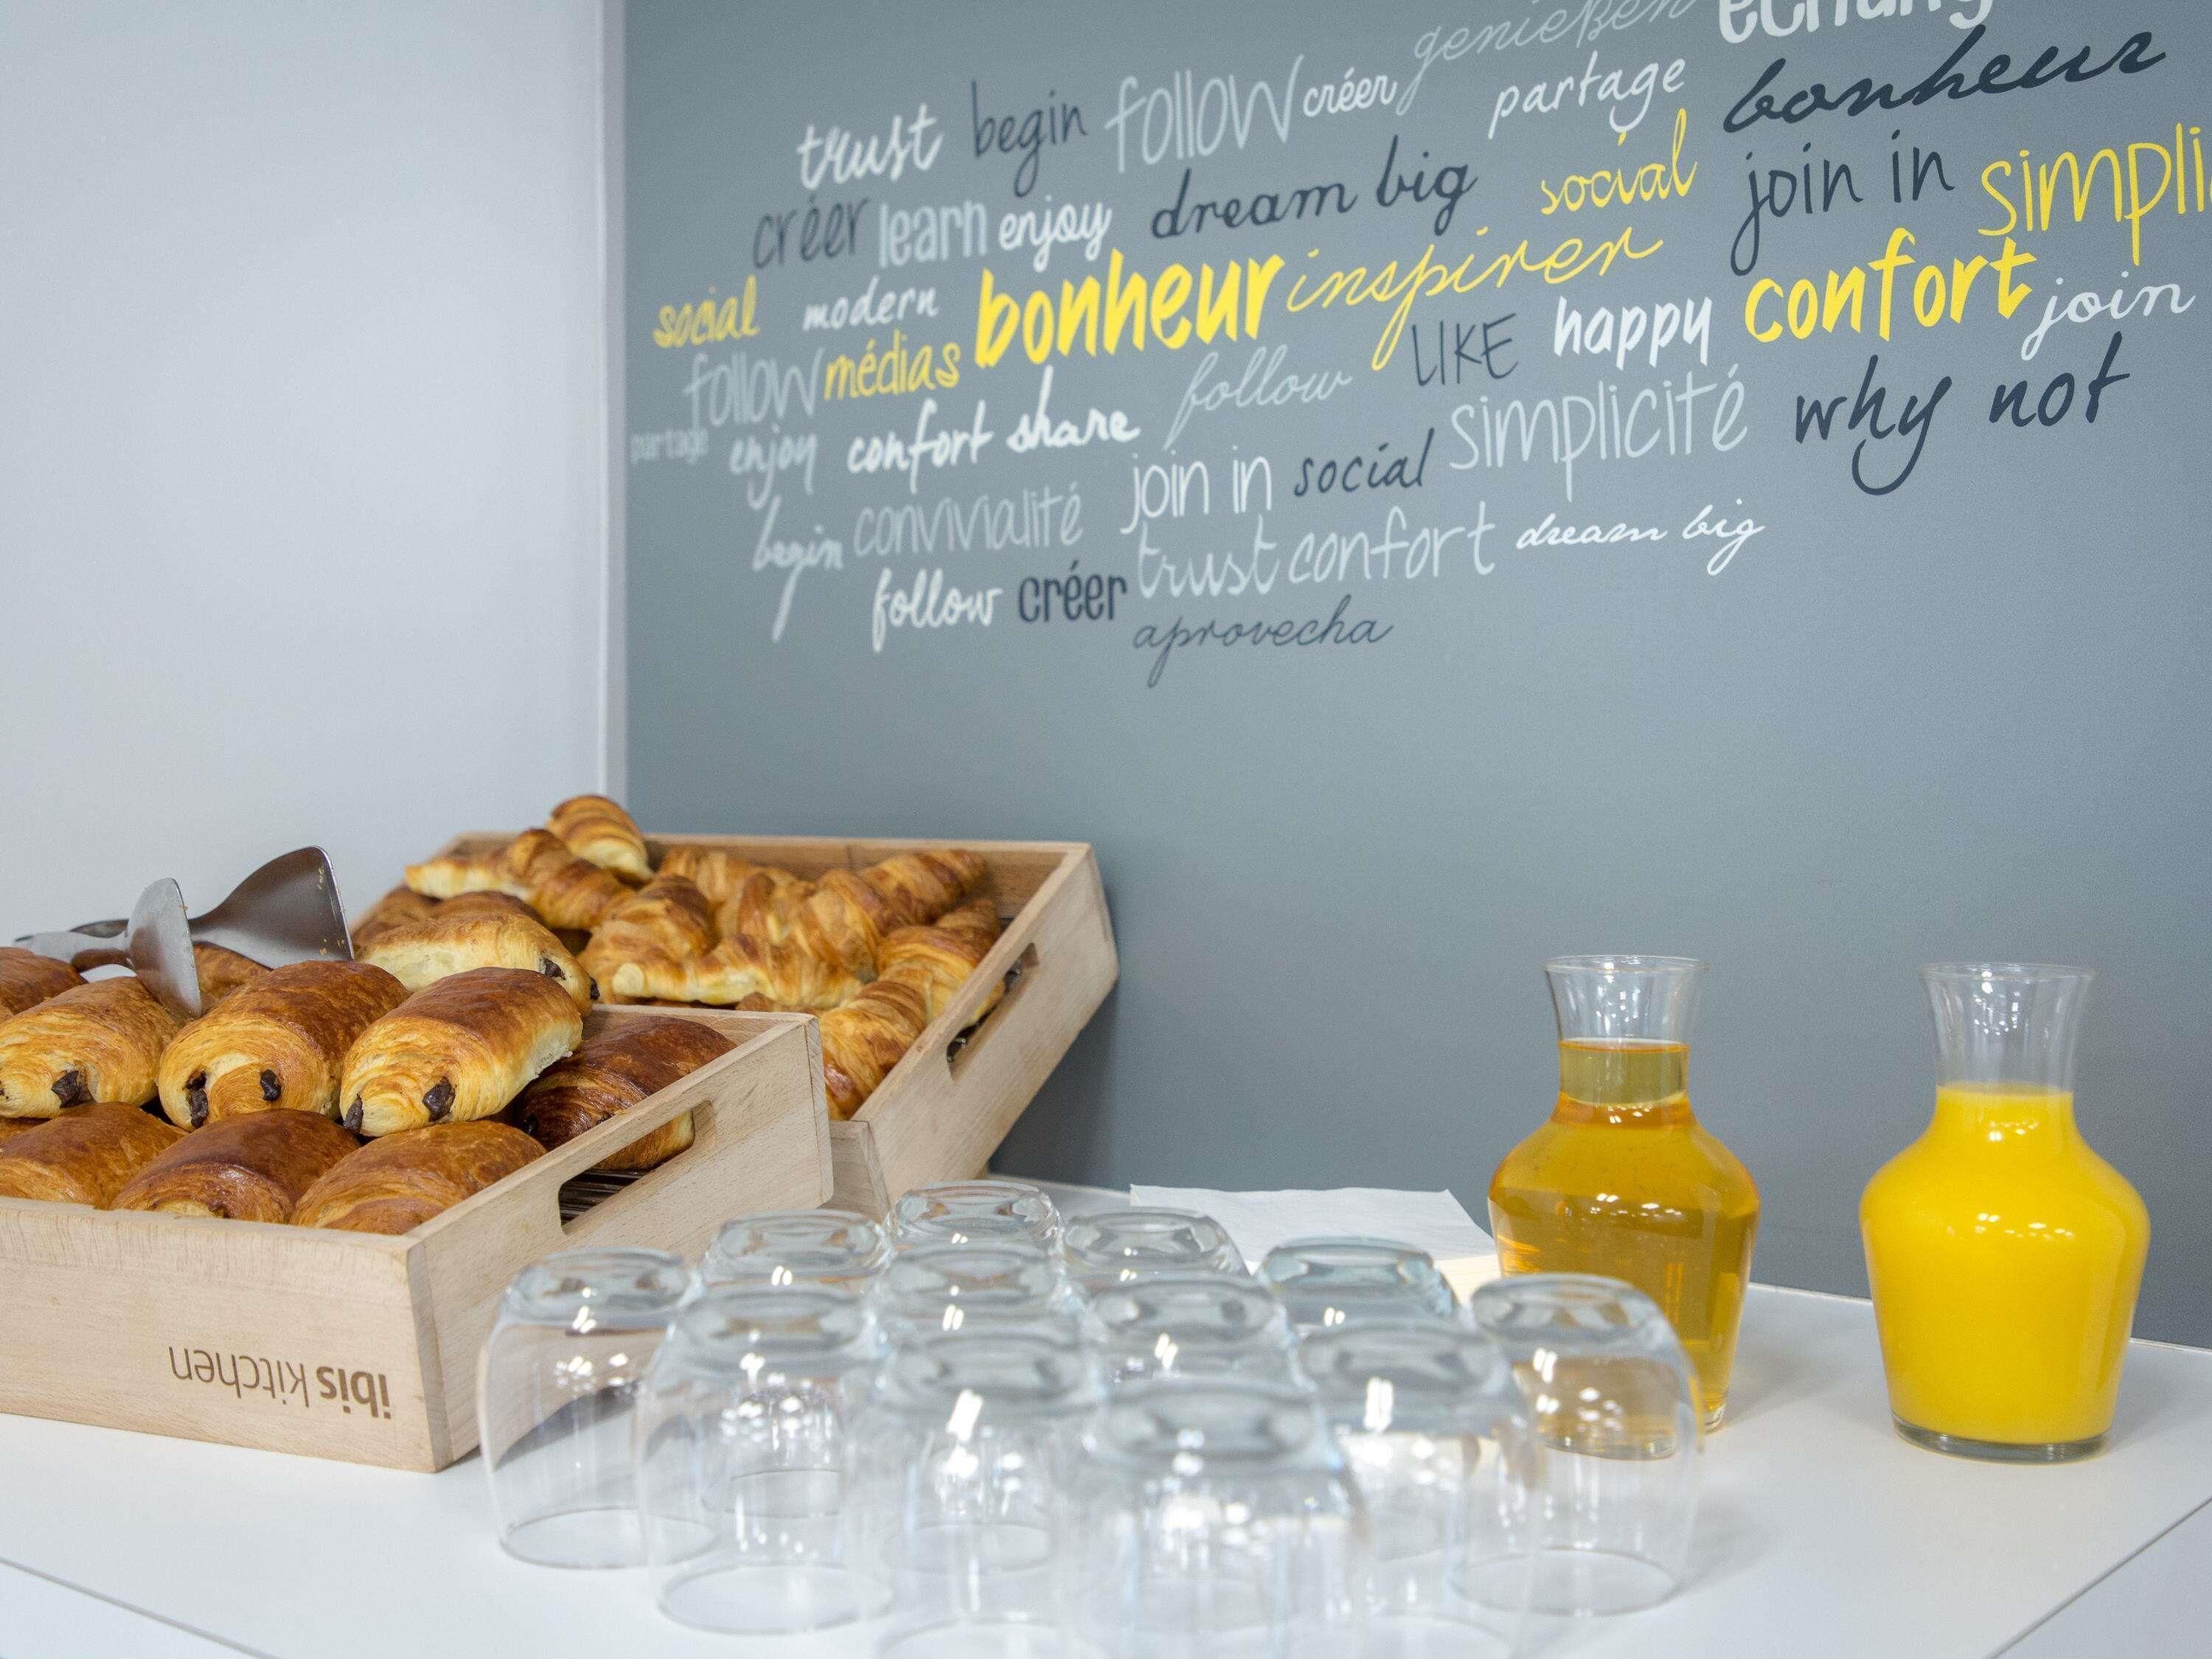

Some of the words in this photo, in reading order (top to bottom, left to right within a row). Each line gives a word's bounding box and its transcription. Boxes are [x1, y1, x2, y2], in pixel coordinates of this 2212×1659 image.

[1105, 55, 1304, 173] follow
[1302, 67, 1399, 116] créer
[1488, 50, 1686, 139] partage
[1722, 24, 2167, 133] bonheur
[796, 104, 944, 189] trust
[972, 80, 1088, 198] begin
[1540, 108, 1698, 215] social
[752, 192, 870, 269] créer
[1152, 167, 1358, 239] dream
[1376, 134, 1478, 237] big
[1730, 142, 1864, 276] join
[1890, 130, 1955, 204] in
[1978, 122, 2212, 266] simpli
[879, 200, 988, 268] learn
[998, 195, 1113, 273] enjoy
[653, 274, 760, 349] social
[802, 275, 939, 333] modern
[974, 248, 1285, 369] bonheur
[1286, 226, 1664, 372] inspirer
[1744, 226, 2038, 343] confort
[2021, 270, 2197, 361] join
[824, 328, 961, 401] médias
[1412, 313, 1519, 387] LIKE
[1553, 294, 1712, 369] happy
[684, 347, 826, 430] follow
[1006, 364, 1142, 453] share
[1163, 343, 1354, 453] follow
[1449, 363, 1749, 503] simplicité
[1795, 354, 1952, 495] why
[1988, 330, 2131, 426] not
[729, 422, 818, 511] enjoy
[846, 397, 995, 495] confort
[1119, 448, 1211, 535] join
[1231, 444, 1273, 515] in
[1294, 428, 1435, 498] social
[751, 495, 844, 644] begin
[1137, 514, 1281, 599] trust
[1288, 500, 1497, 585] confort
[1515, 513, 1668, 551] dream
[1681, 498, 1766, 576] big
[872, 568, 1005, 653] follow
[1018, 559, 1128, 624] créer
[1133, 594, 1395, 688] aprovecha
[168, 1346, 310, 1408] kitchen
[316, 1365, 392, 1419] ibis
